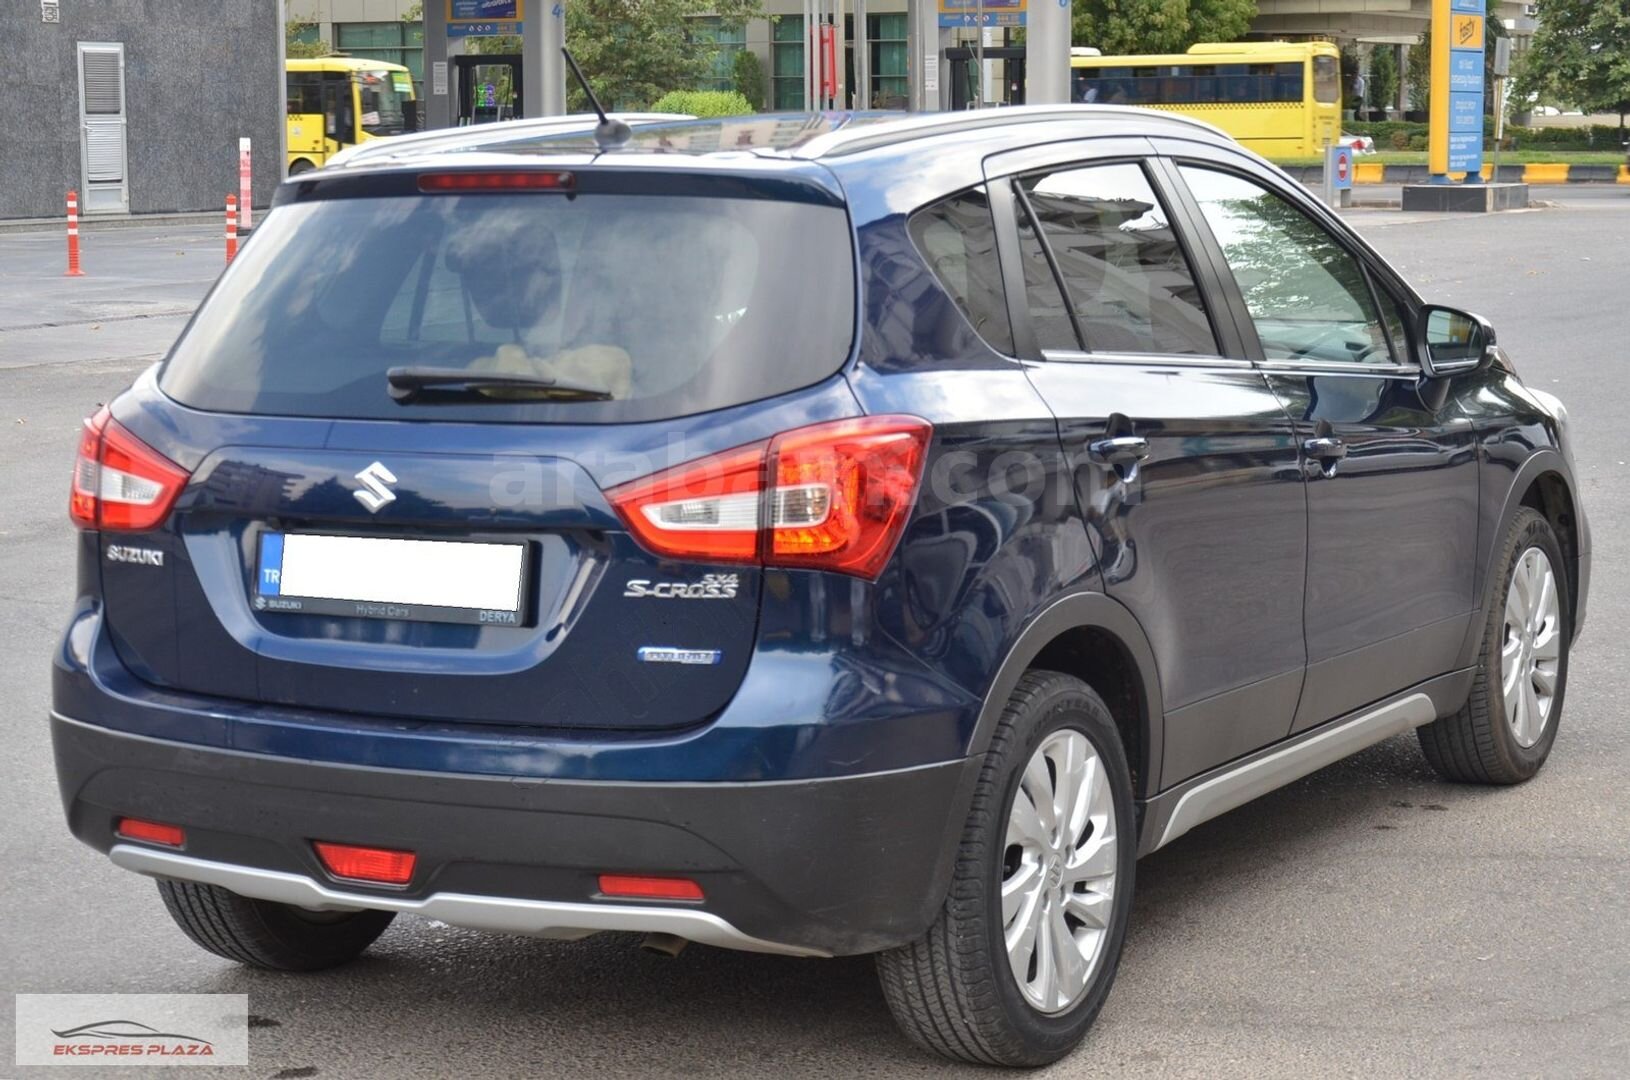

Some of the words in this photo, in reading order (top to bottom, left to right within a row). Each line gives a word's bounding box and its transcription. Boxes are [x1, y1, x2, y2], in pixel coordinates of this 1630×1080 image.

[106, 544, 164, 567] SUZUKI
[263, 568, 280, 584] TR
[701, 574, 739, 584] SX4
[623, 580, 739, 598] S-CROSS
[268, 599, 302, 609] SUZUKI
[356, 604, 386, 617] Hybrid
[386, 605, 409, 617] Cars
[479, 610, 516, 624] DERYA
